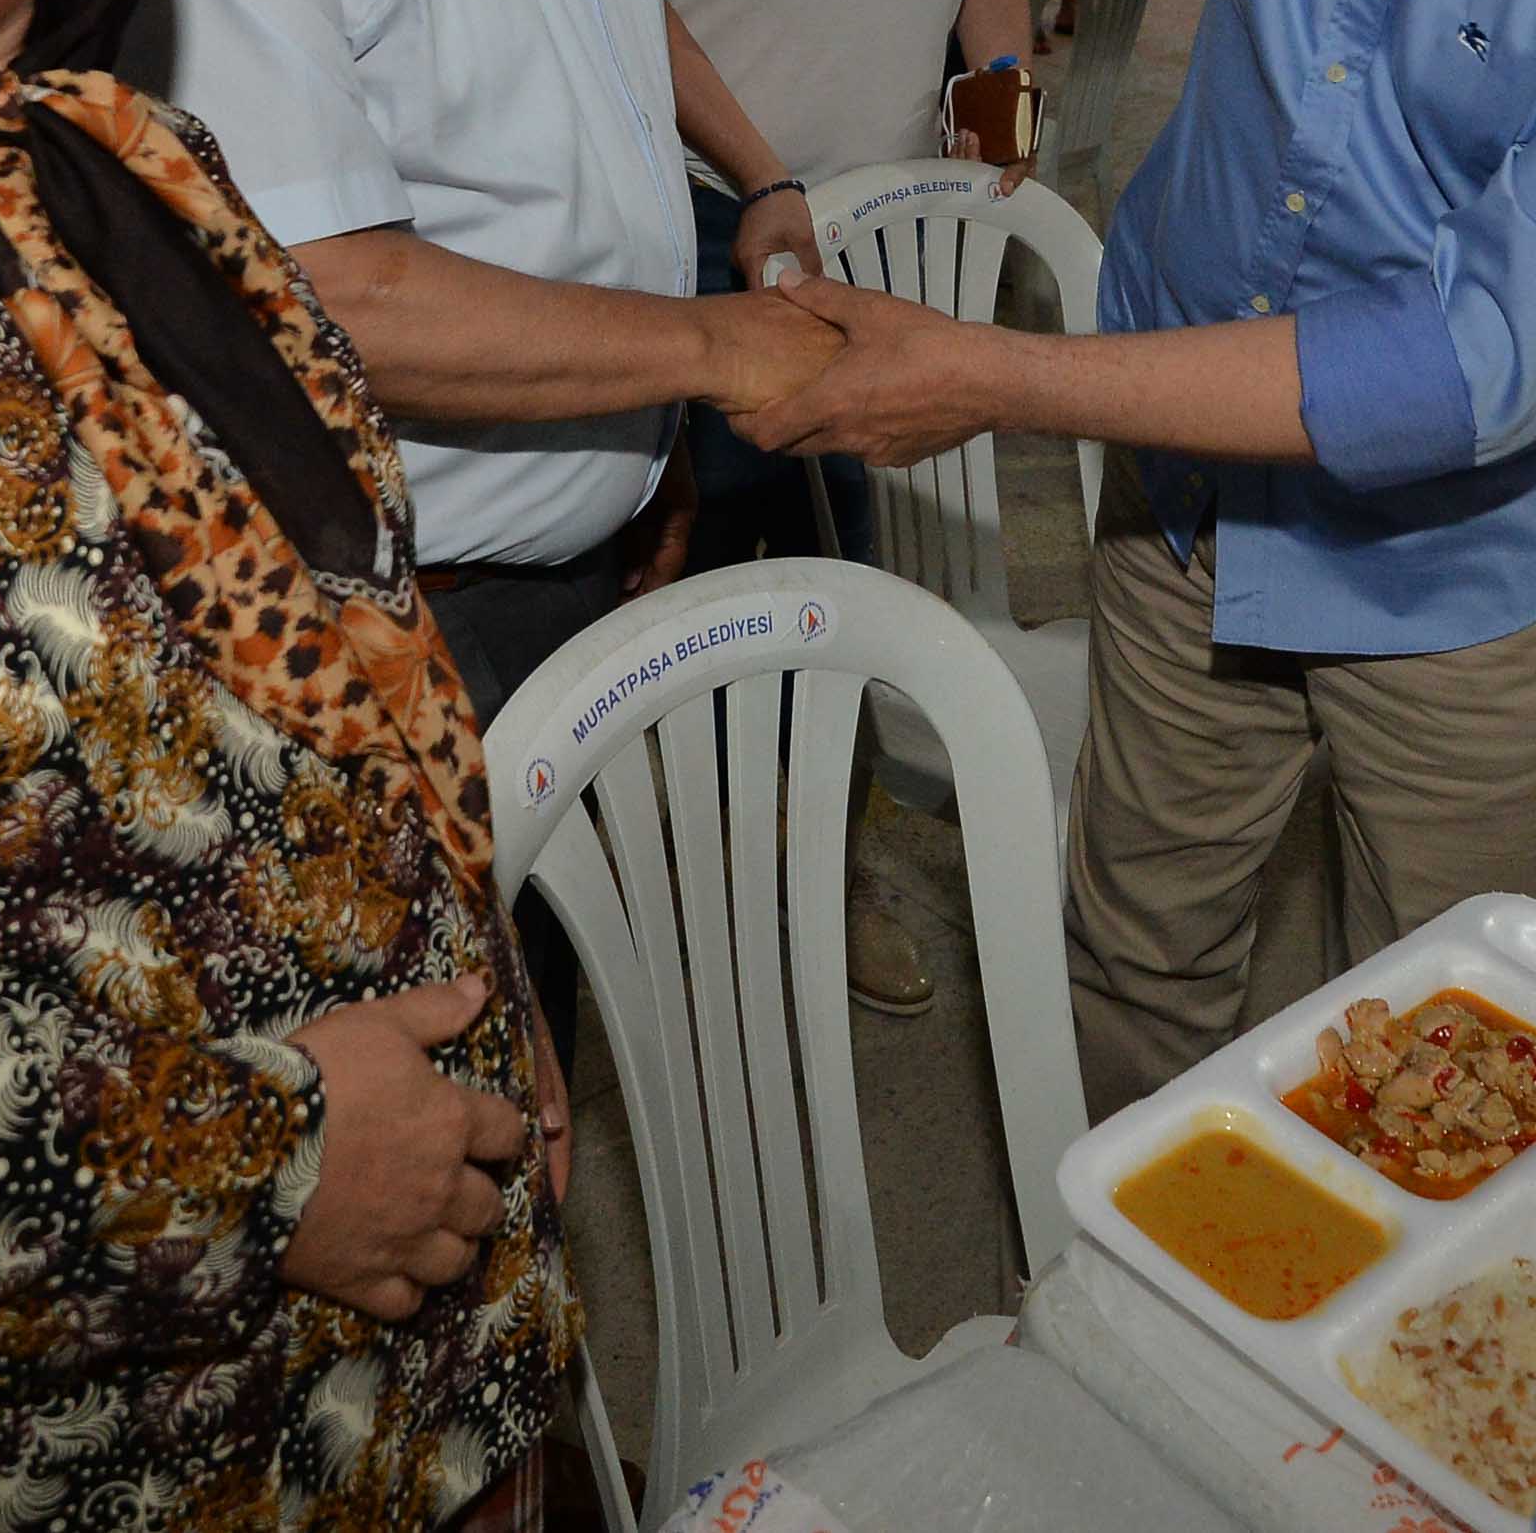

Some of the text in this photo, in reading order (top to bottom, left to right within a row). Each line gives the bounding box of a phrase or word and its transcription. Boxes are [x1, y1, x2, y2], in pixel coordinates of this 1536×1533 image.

[852, 186, 912, 223] MURATPAŞA
[913, 177, 972, 196] BELEDİYESİ
[571, 652, 673, 745] MURATPAŞA
[675, 611, 774, 662] BELEDİYESİ
